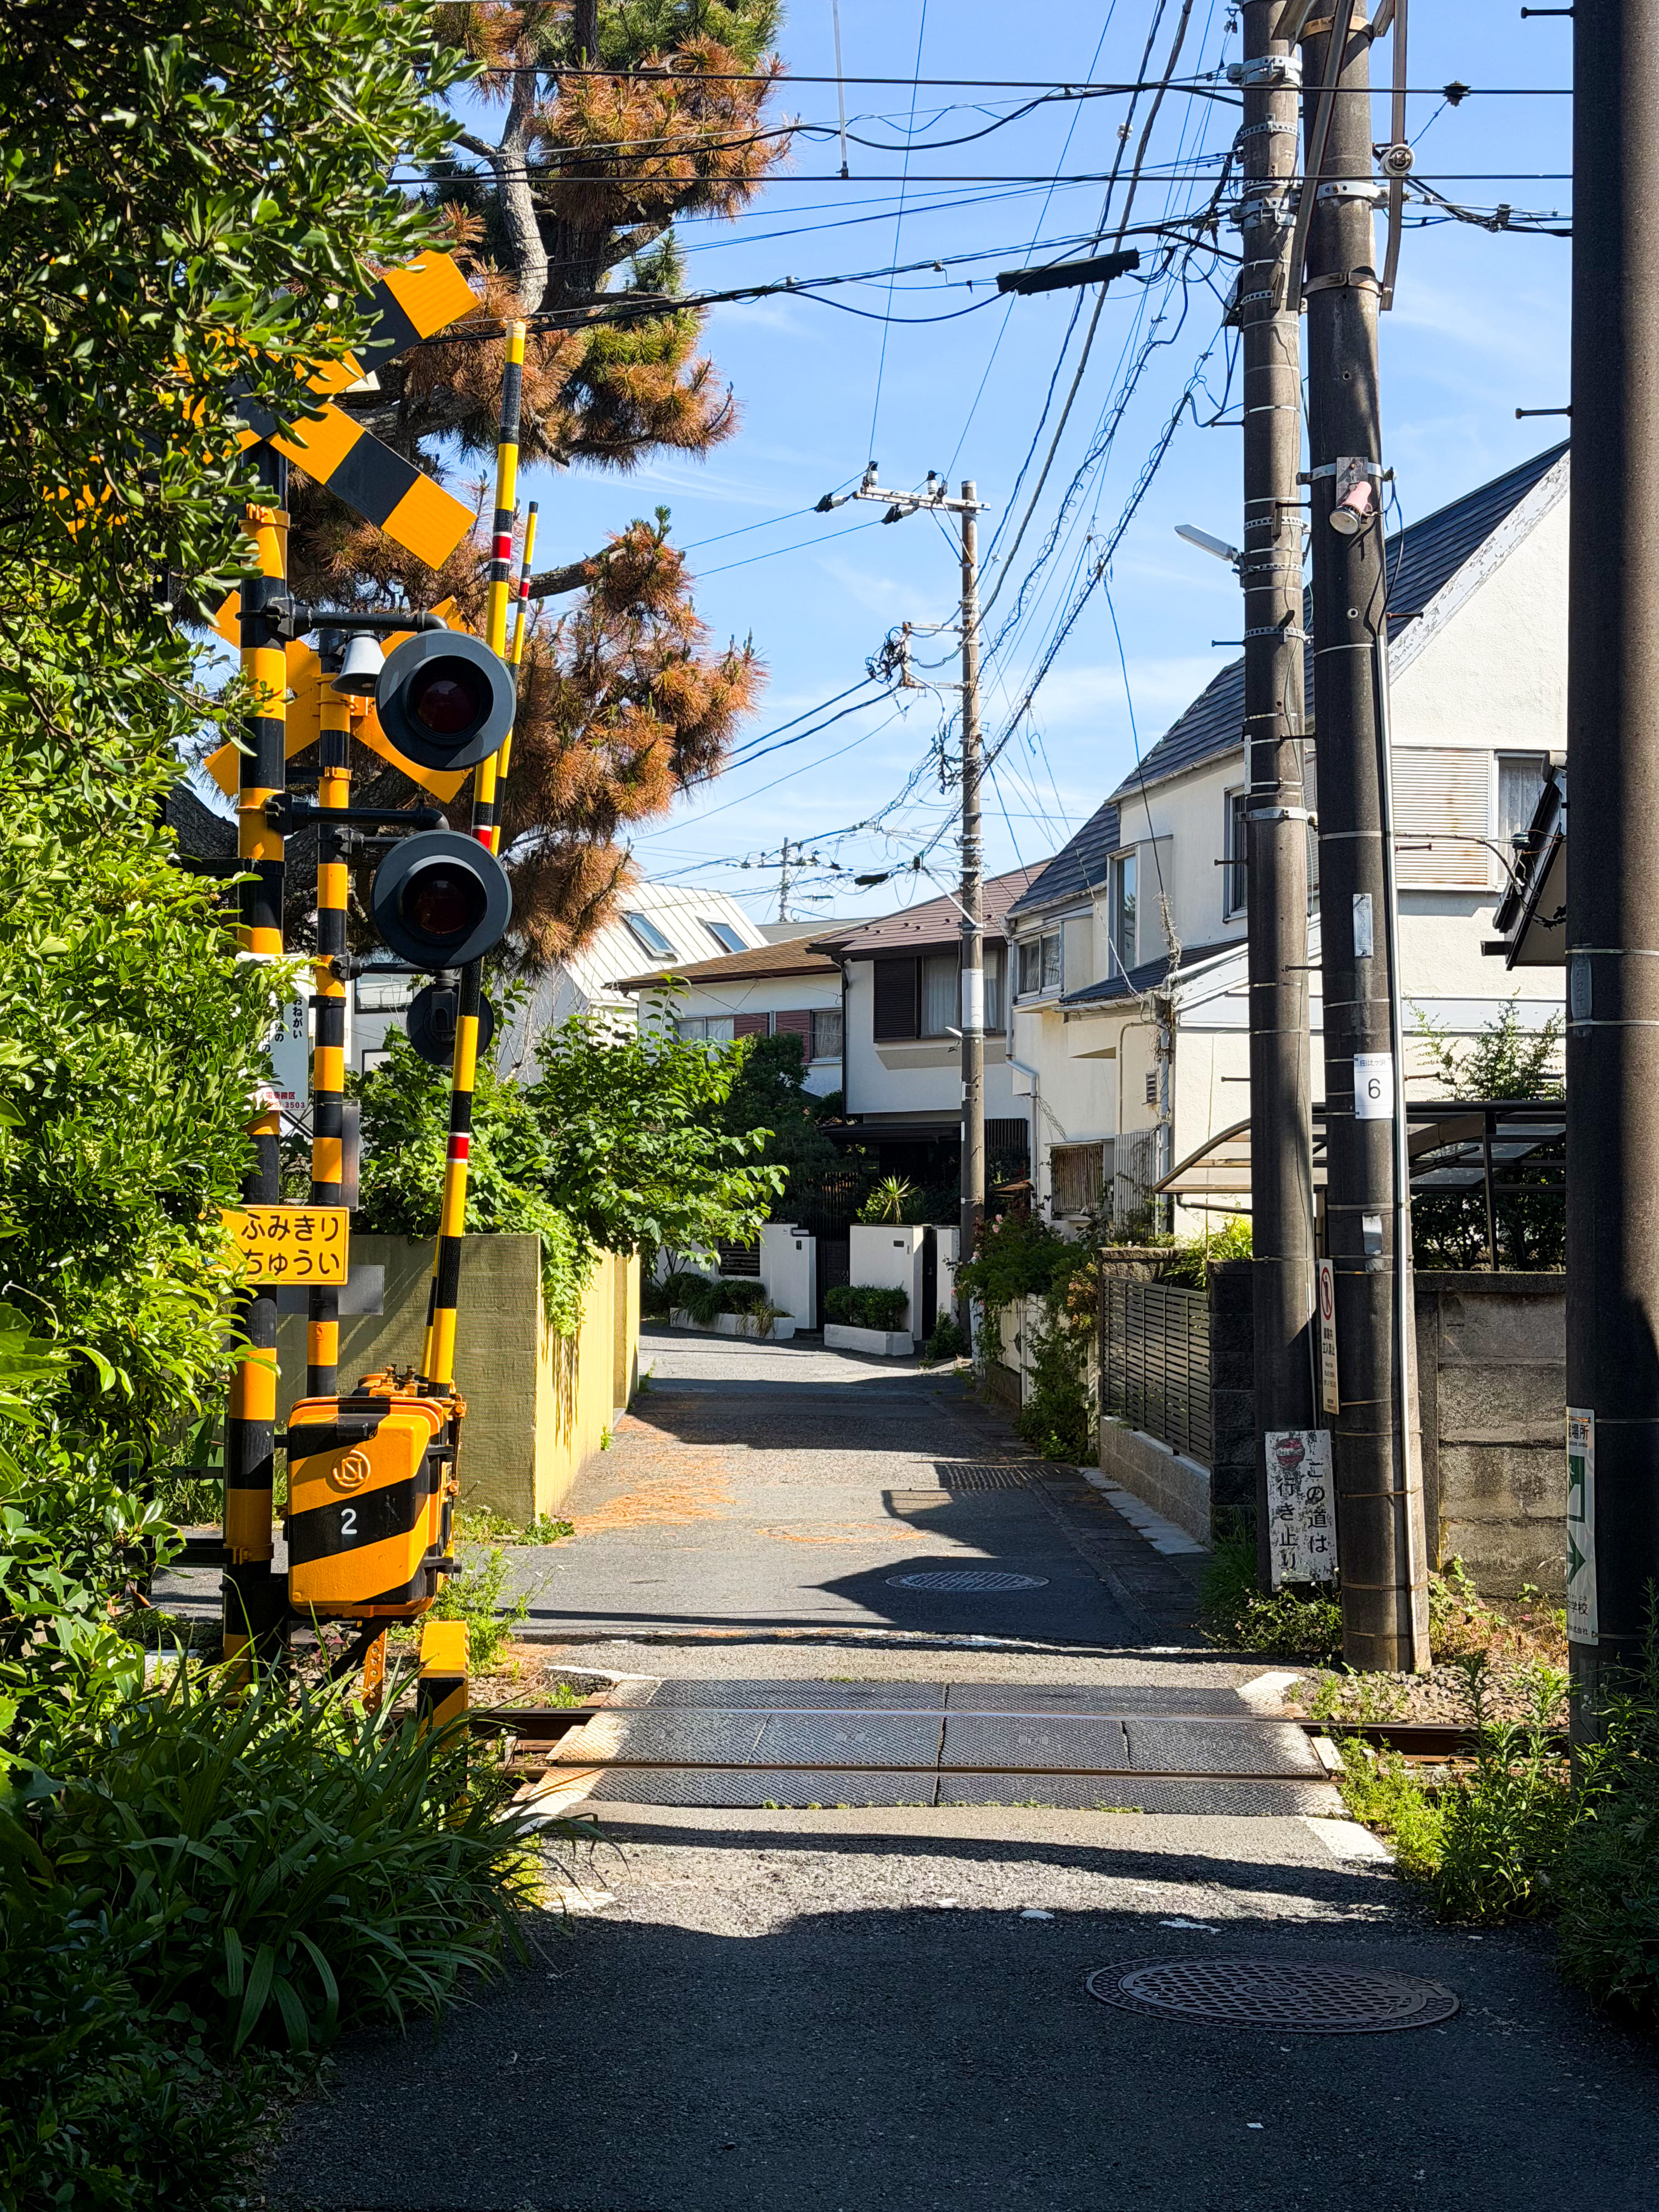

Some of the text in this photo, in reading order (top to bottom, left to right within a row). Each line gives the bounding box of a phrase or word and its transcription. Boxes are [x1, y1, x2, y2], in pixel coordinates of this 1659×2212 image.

[1368, 1078, 1380, 1099] 6
[241, 1213, 338, 1242] ふみきり
[243, 1248, 339, 1276] ちゅうい
[341, 1508, 358, 1534] 2
[1306, 1462, 1328, 1553] この道は
[1277, 1478, 1298, 1568] 行き止り
